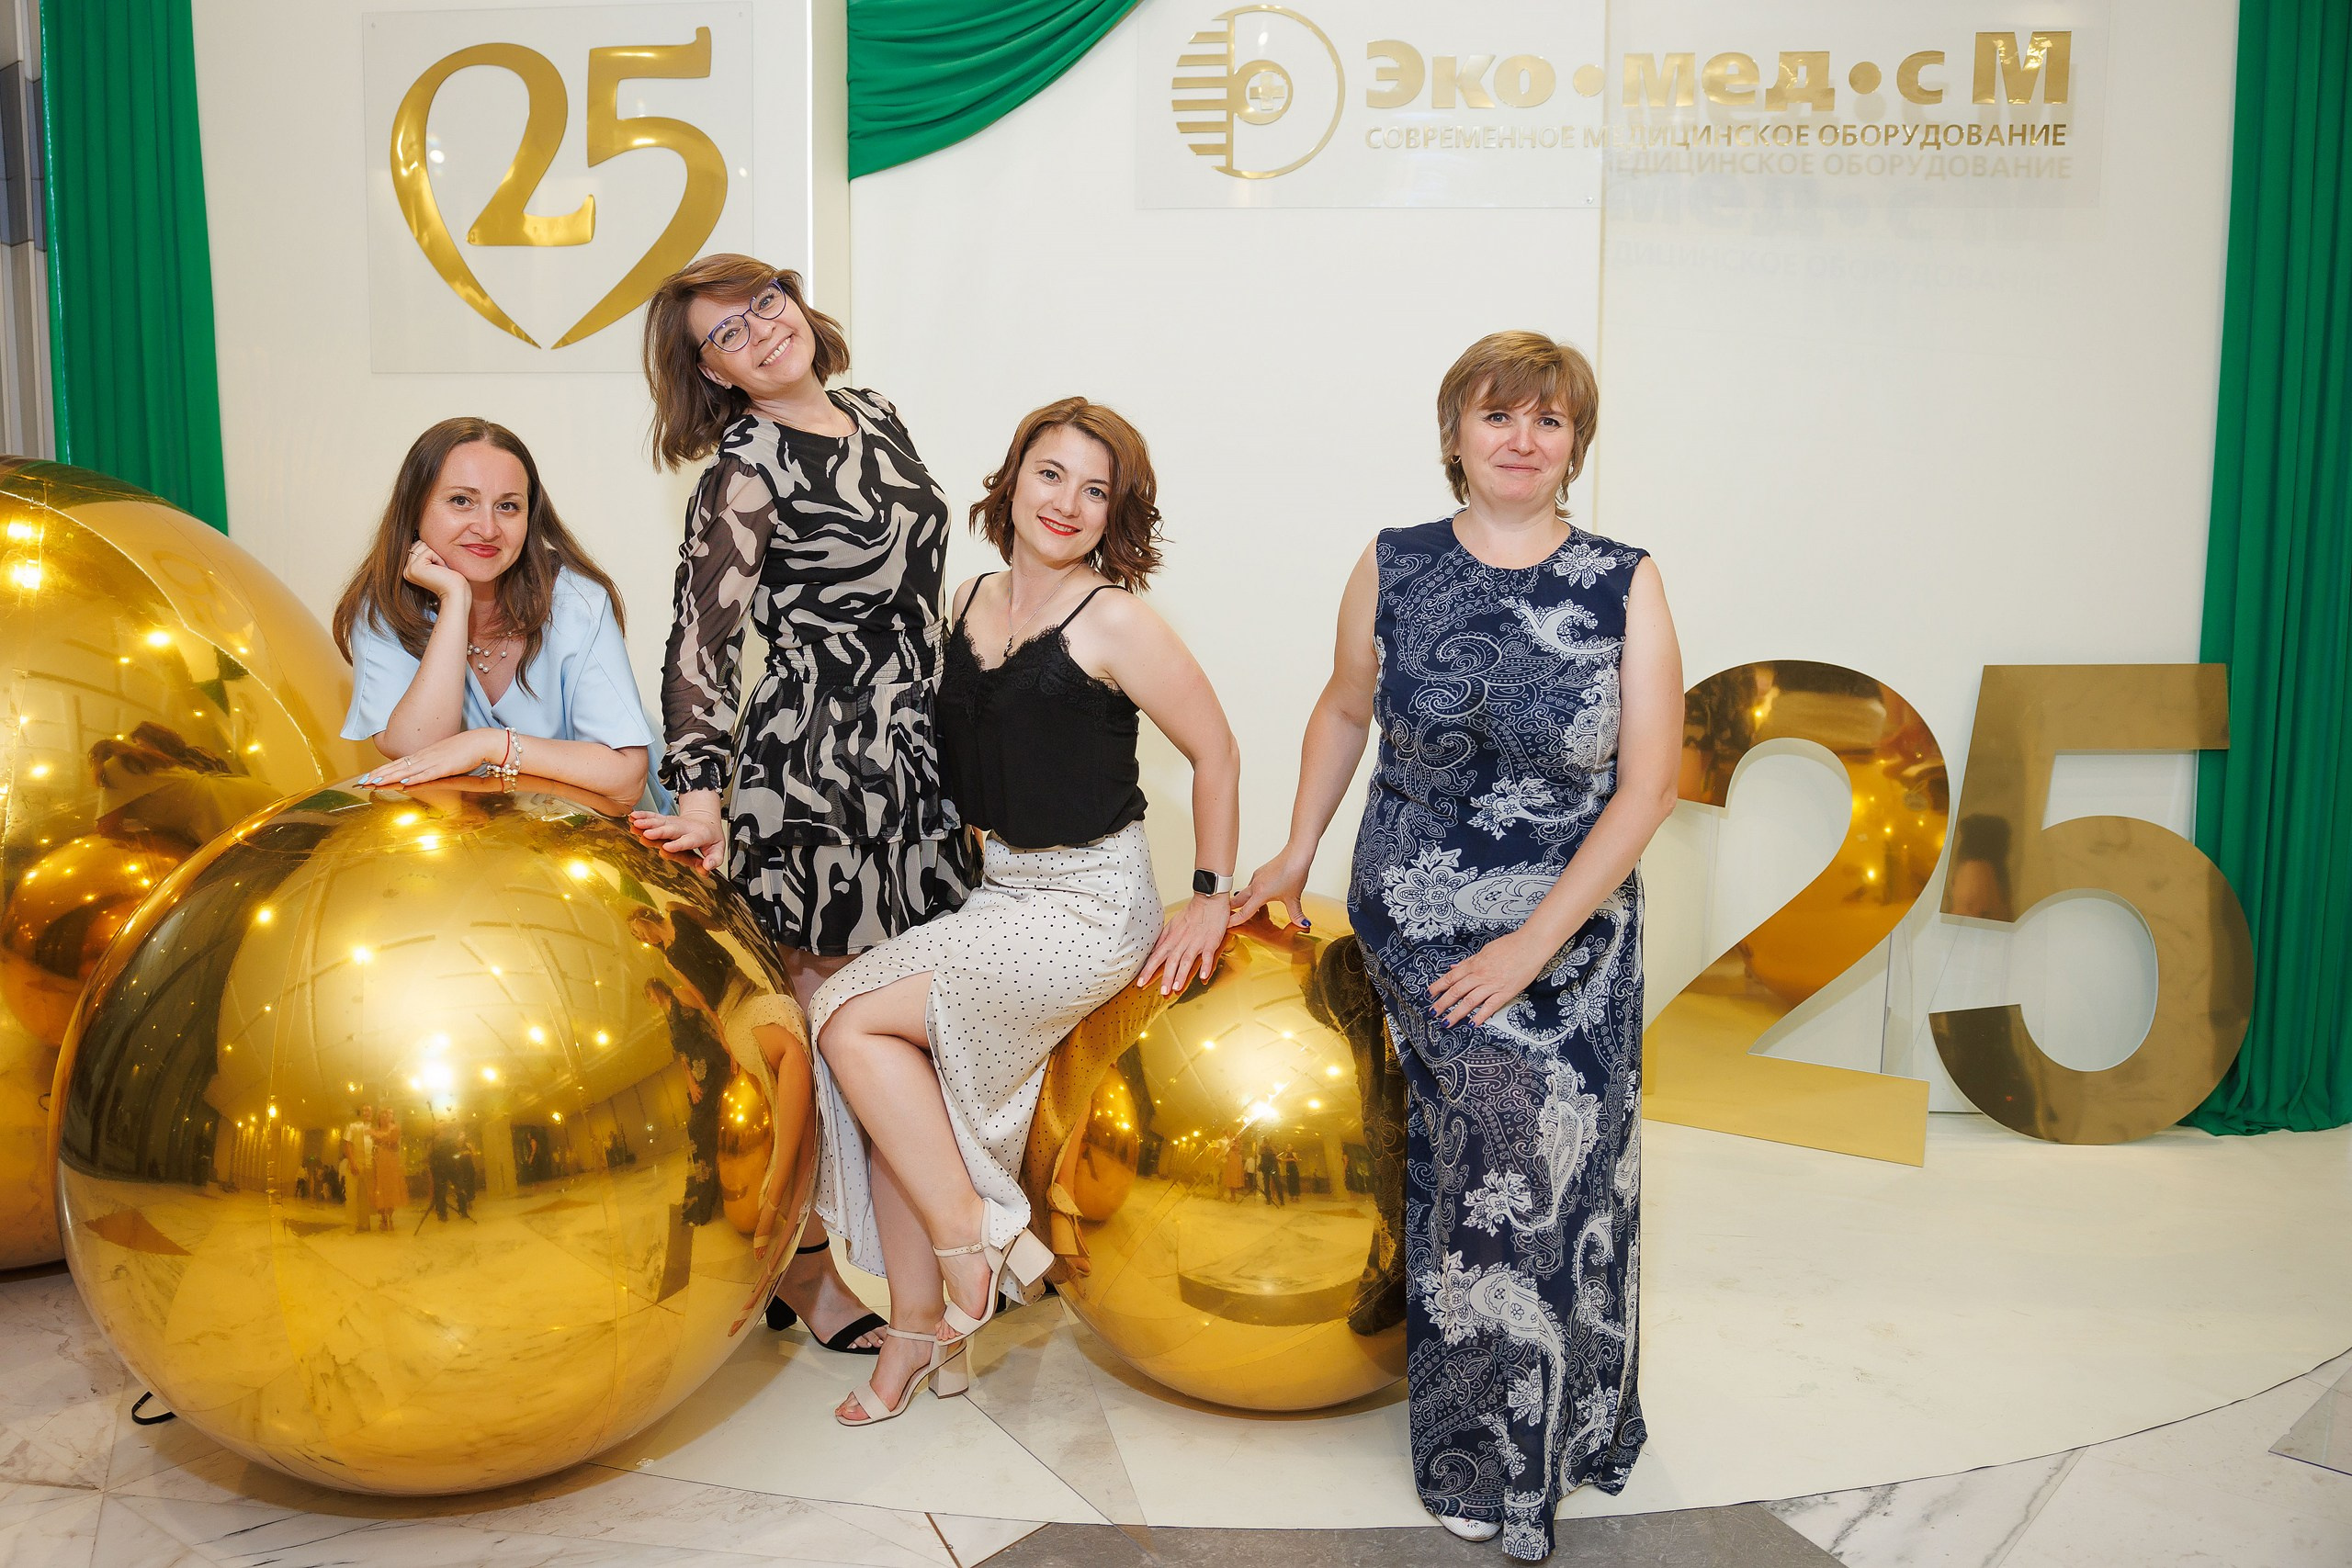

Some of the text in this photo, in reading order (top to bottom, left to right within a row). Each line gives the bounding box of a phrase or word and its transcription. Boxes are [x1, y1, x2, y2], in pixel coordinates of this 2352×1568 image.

[390, 26, 728, 350] 25
[1364, 123, 2067, 152] СОВРЕМЕННОЕ МЕДИЦИНСКОЕ ОБОРУДОВАНИЕ
[1642, 660, 2255, 1168] 25
